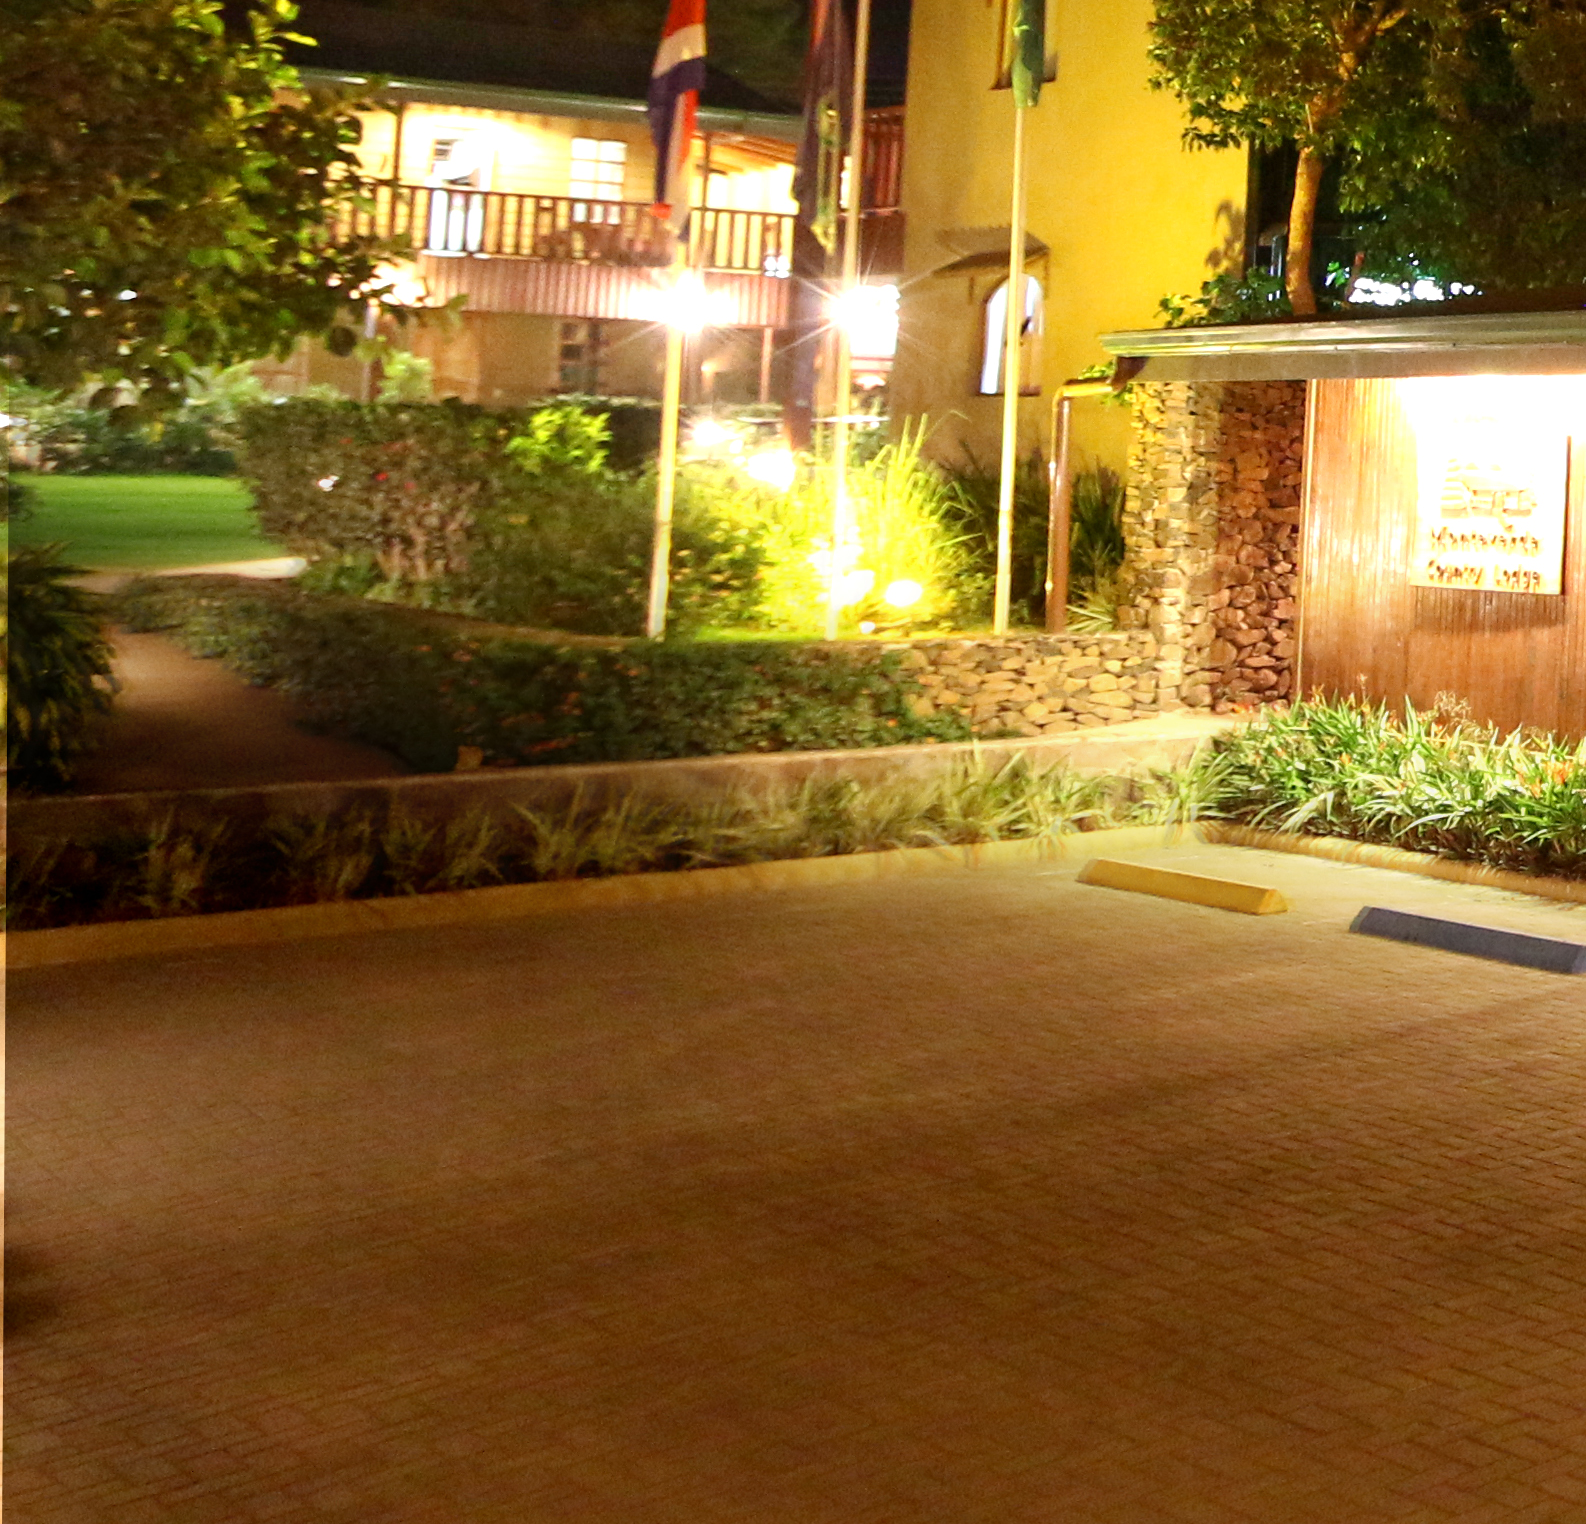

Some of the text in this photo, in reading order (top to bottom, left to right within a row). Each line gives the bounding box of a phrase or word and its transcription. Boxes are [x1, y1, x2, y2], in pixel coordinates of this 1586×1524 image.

[1430, 526, 1542, 557] Monteverde
[1427, 558, 1542, 593] Country Lodge
